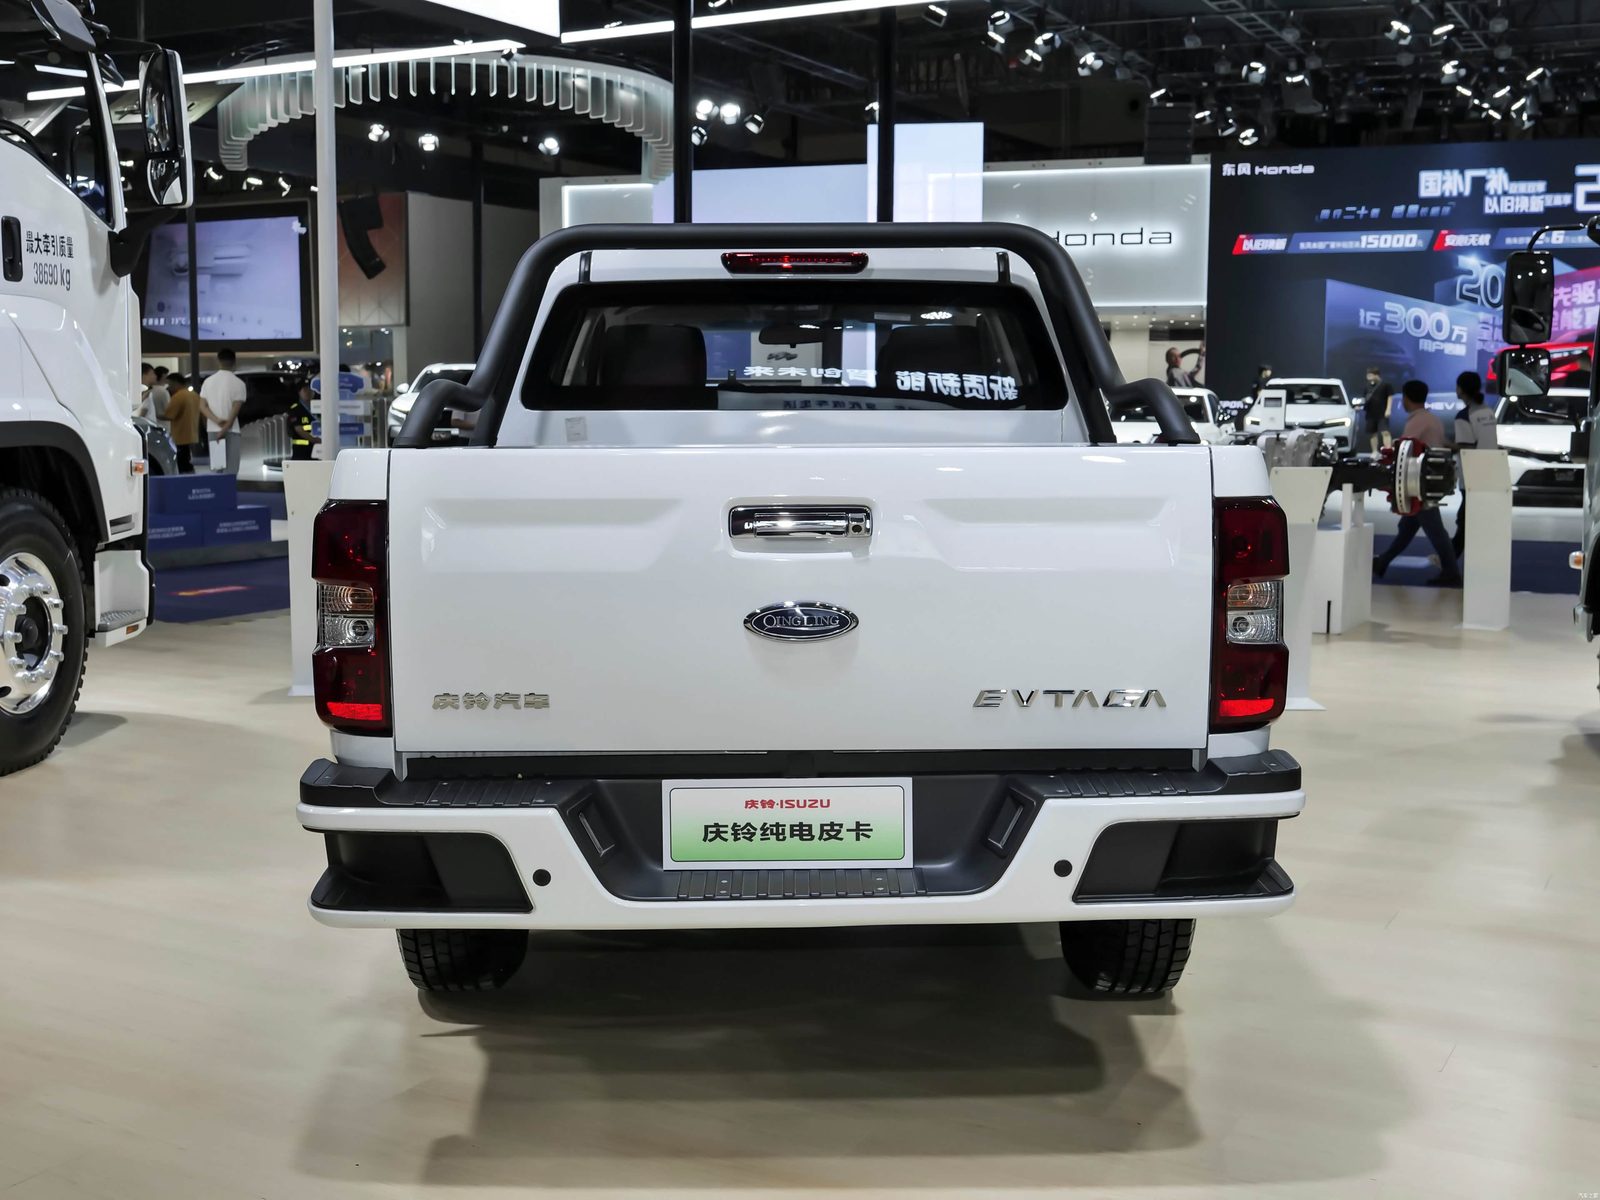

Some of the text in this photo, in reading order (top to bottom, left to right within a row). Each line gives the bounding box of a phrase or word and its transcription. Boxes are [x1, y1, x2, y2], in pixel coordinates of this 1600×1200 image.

[1222, 163, 1315, 176] 东风 Honda
[26, 230, 74, 259] 最大牵引质量
[1361, 234, 1417, 248] 15000
[34, 262, 71, 291] 38690 kg
[763, 614, 840, 631] QINGLING
[432, 692, 550, 710] 庆铃汽车
[702, 821, 873, 843] 庆铃纯电皮卡
